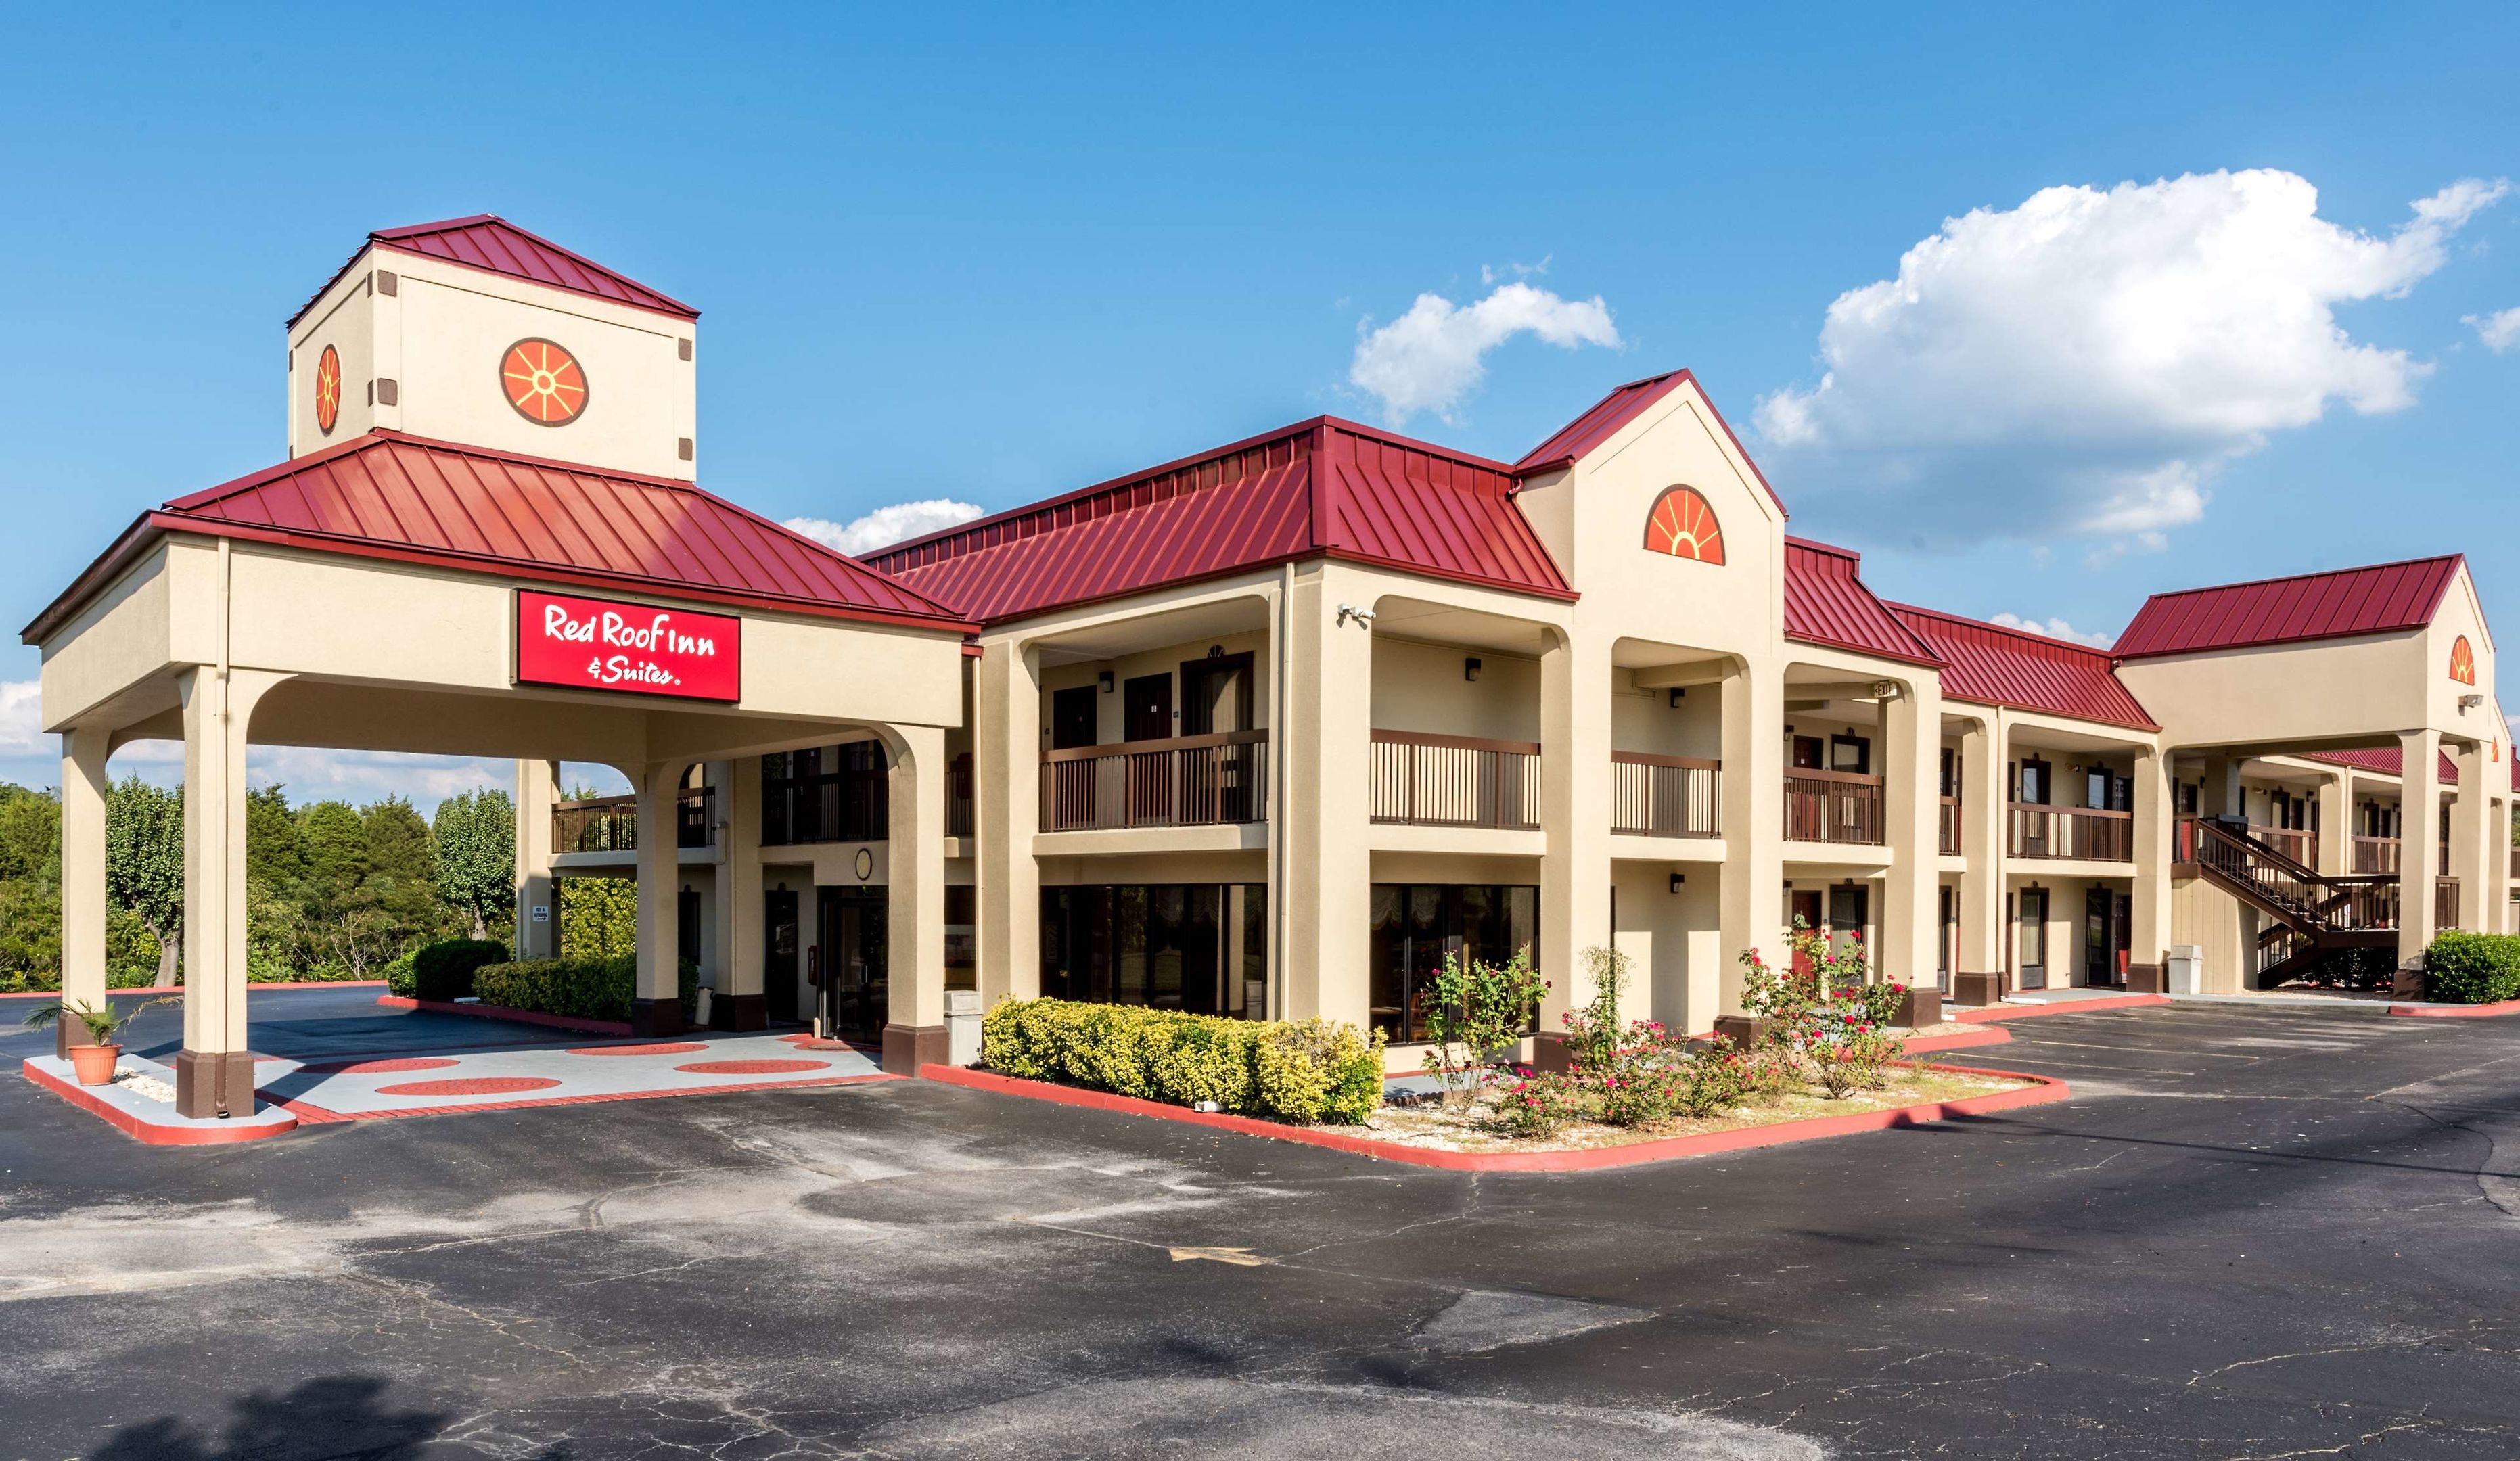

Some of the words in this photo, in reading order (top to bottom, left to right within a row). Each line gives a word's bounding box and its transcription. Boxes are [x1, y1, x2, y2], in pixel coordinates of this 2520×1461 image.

[545, 604, 597, 642] Red
[603, 611, 670, 652] Roof
[668, 629, 715, 656] Inn
[587, 657, 601, 679] &
[601, 655, 674, 685] Suites
[1878, 684, 1892, 695] EXIT
